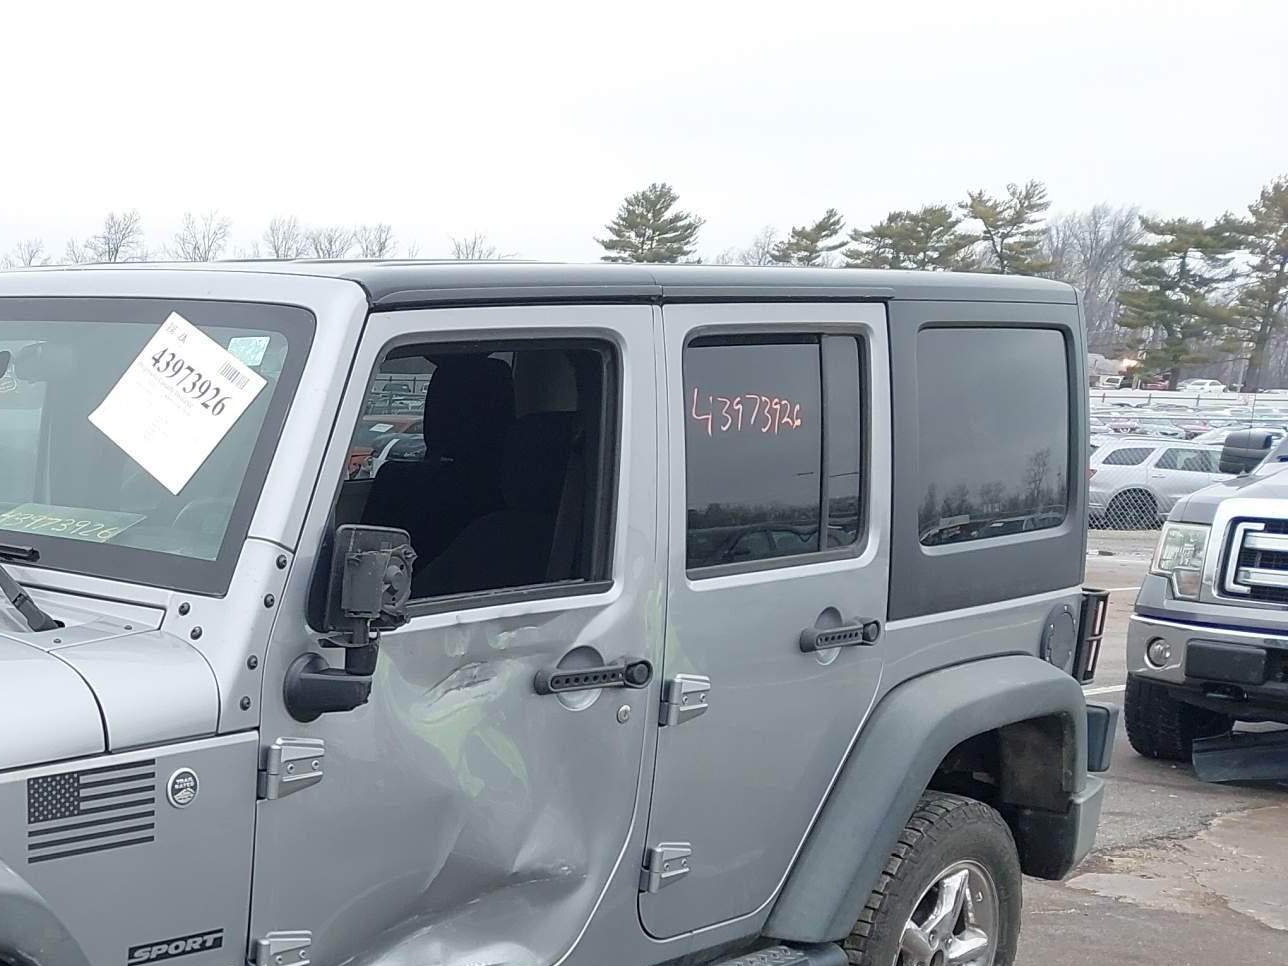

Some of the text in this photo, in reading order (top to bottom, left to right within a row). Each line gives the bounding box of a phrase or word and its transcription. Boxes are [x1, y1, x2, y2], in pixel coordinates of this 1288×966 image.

[151, 347, 233, 417] 43973926
[692, 388, 802, 437] 43973926
[128, 931, 224, 964] SPORT
